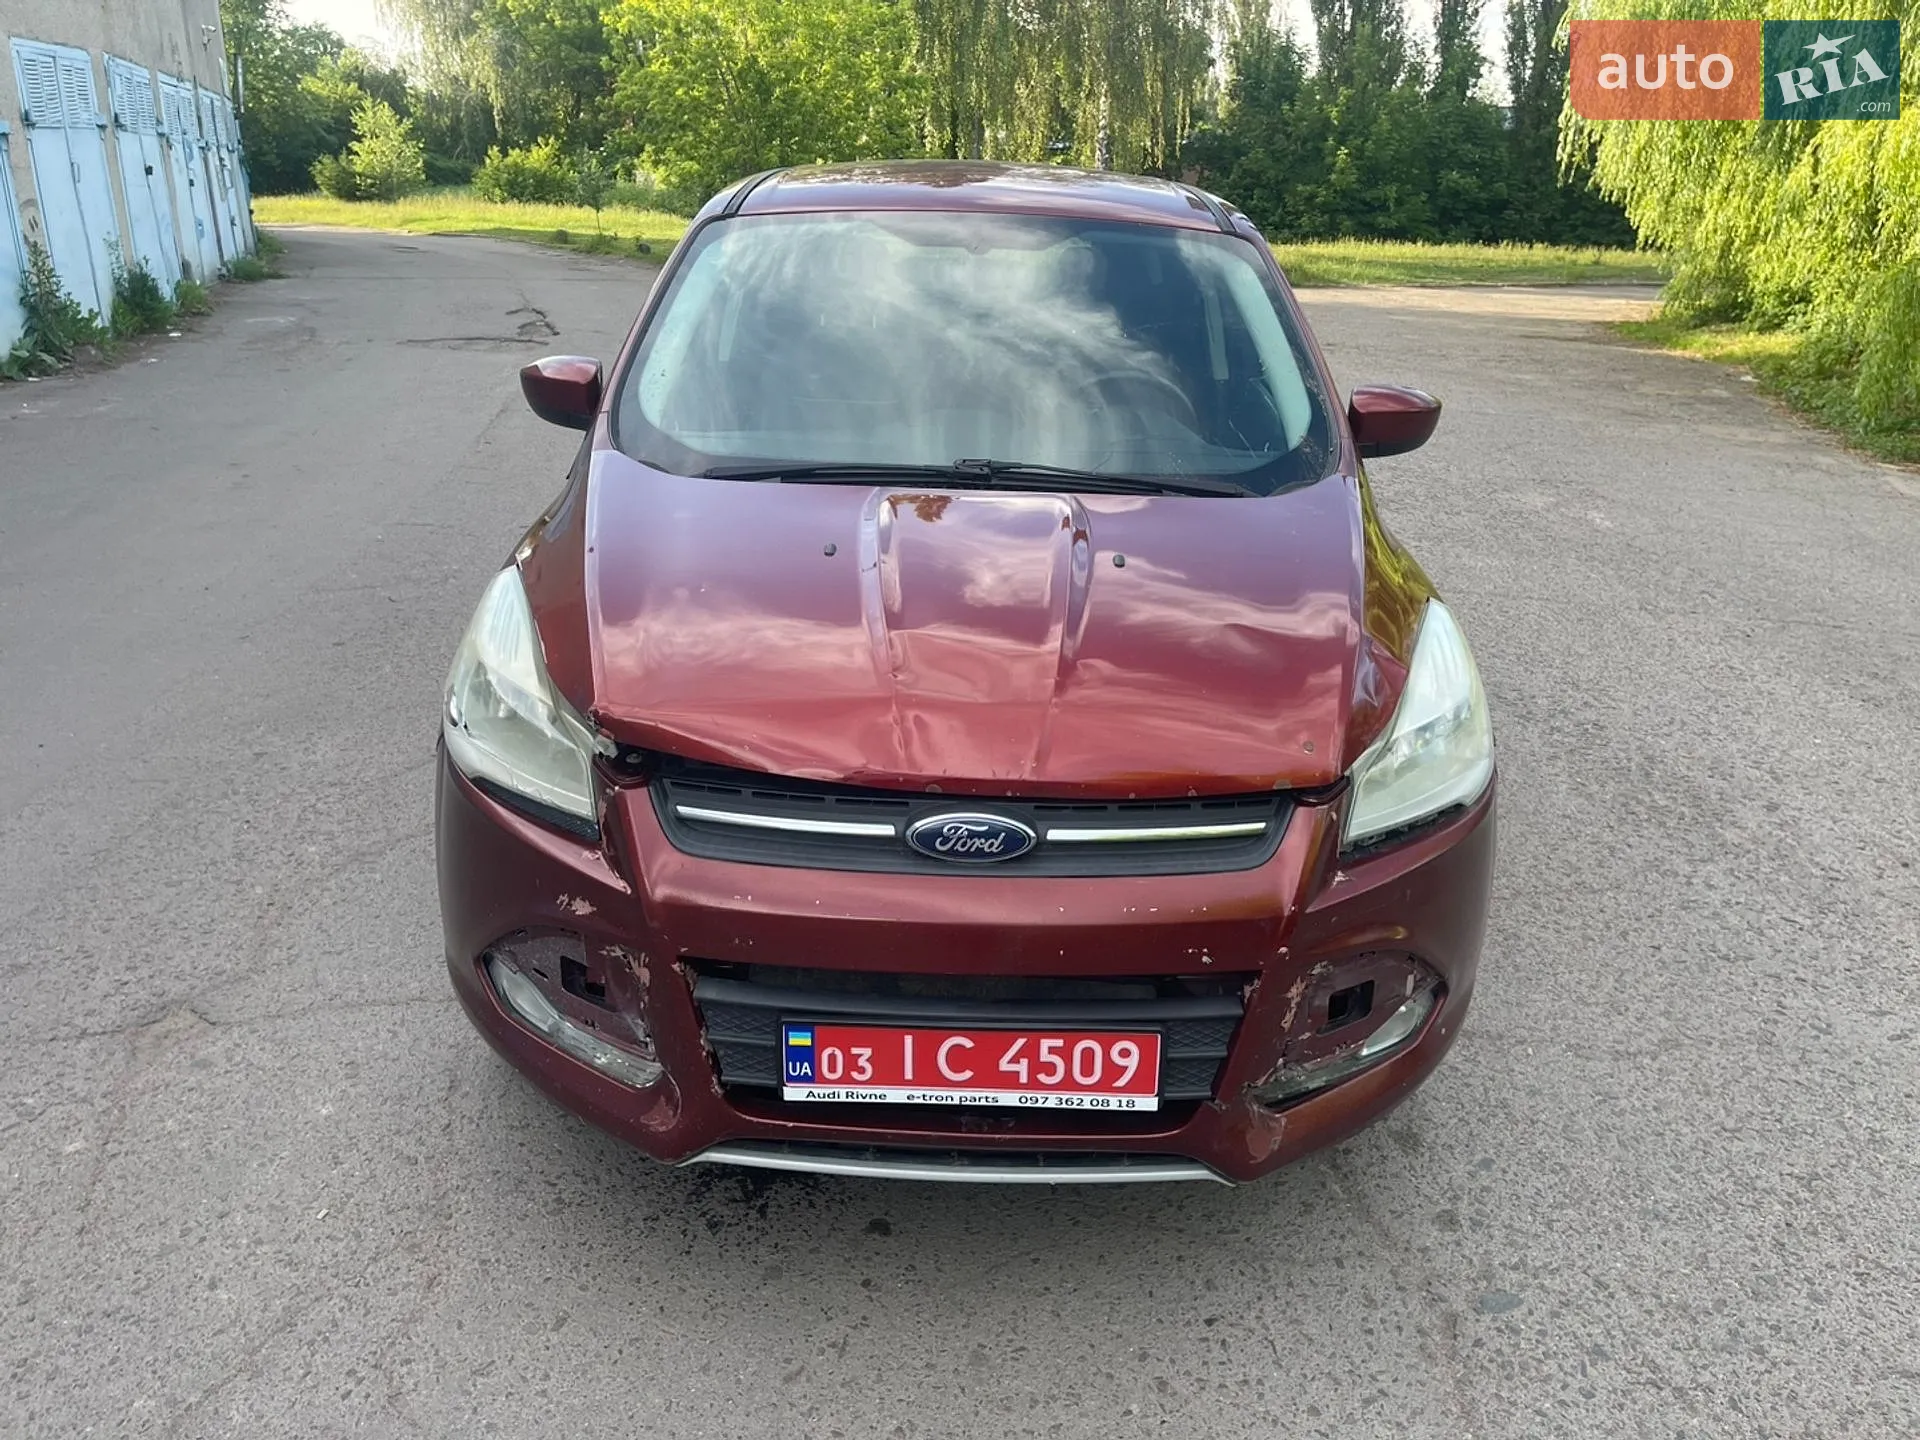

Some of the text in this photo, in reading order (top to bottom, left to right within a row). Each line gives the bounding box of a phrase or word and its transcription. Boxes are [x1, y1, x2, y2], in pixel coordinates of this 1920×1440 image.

[935, 822, 1006, 853] Ford
[788, 1061, 812, 1077] UA
[820, 1046, 874, 1082] 03
[997, 1037, 1141, 1088] 4509
[805, 1090, 1136, 1108] Audi Rivne e-tron parts 097 362 08 18
